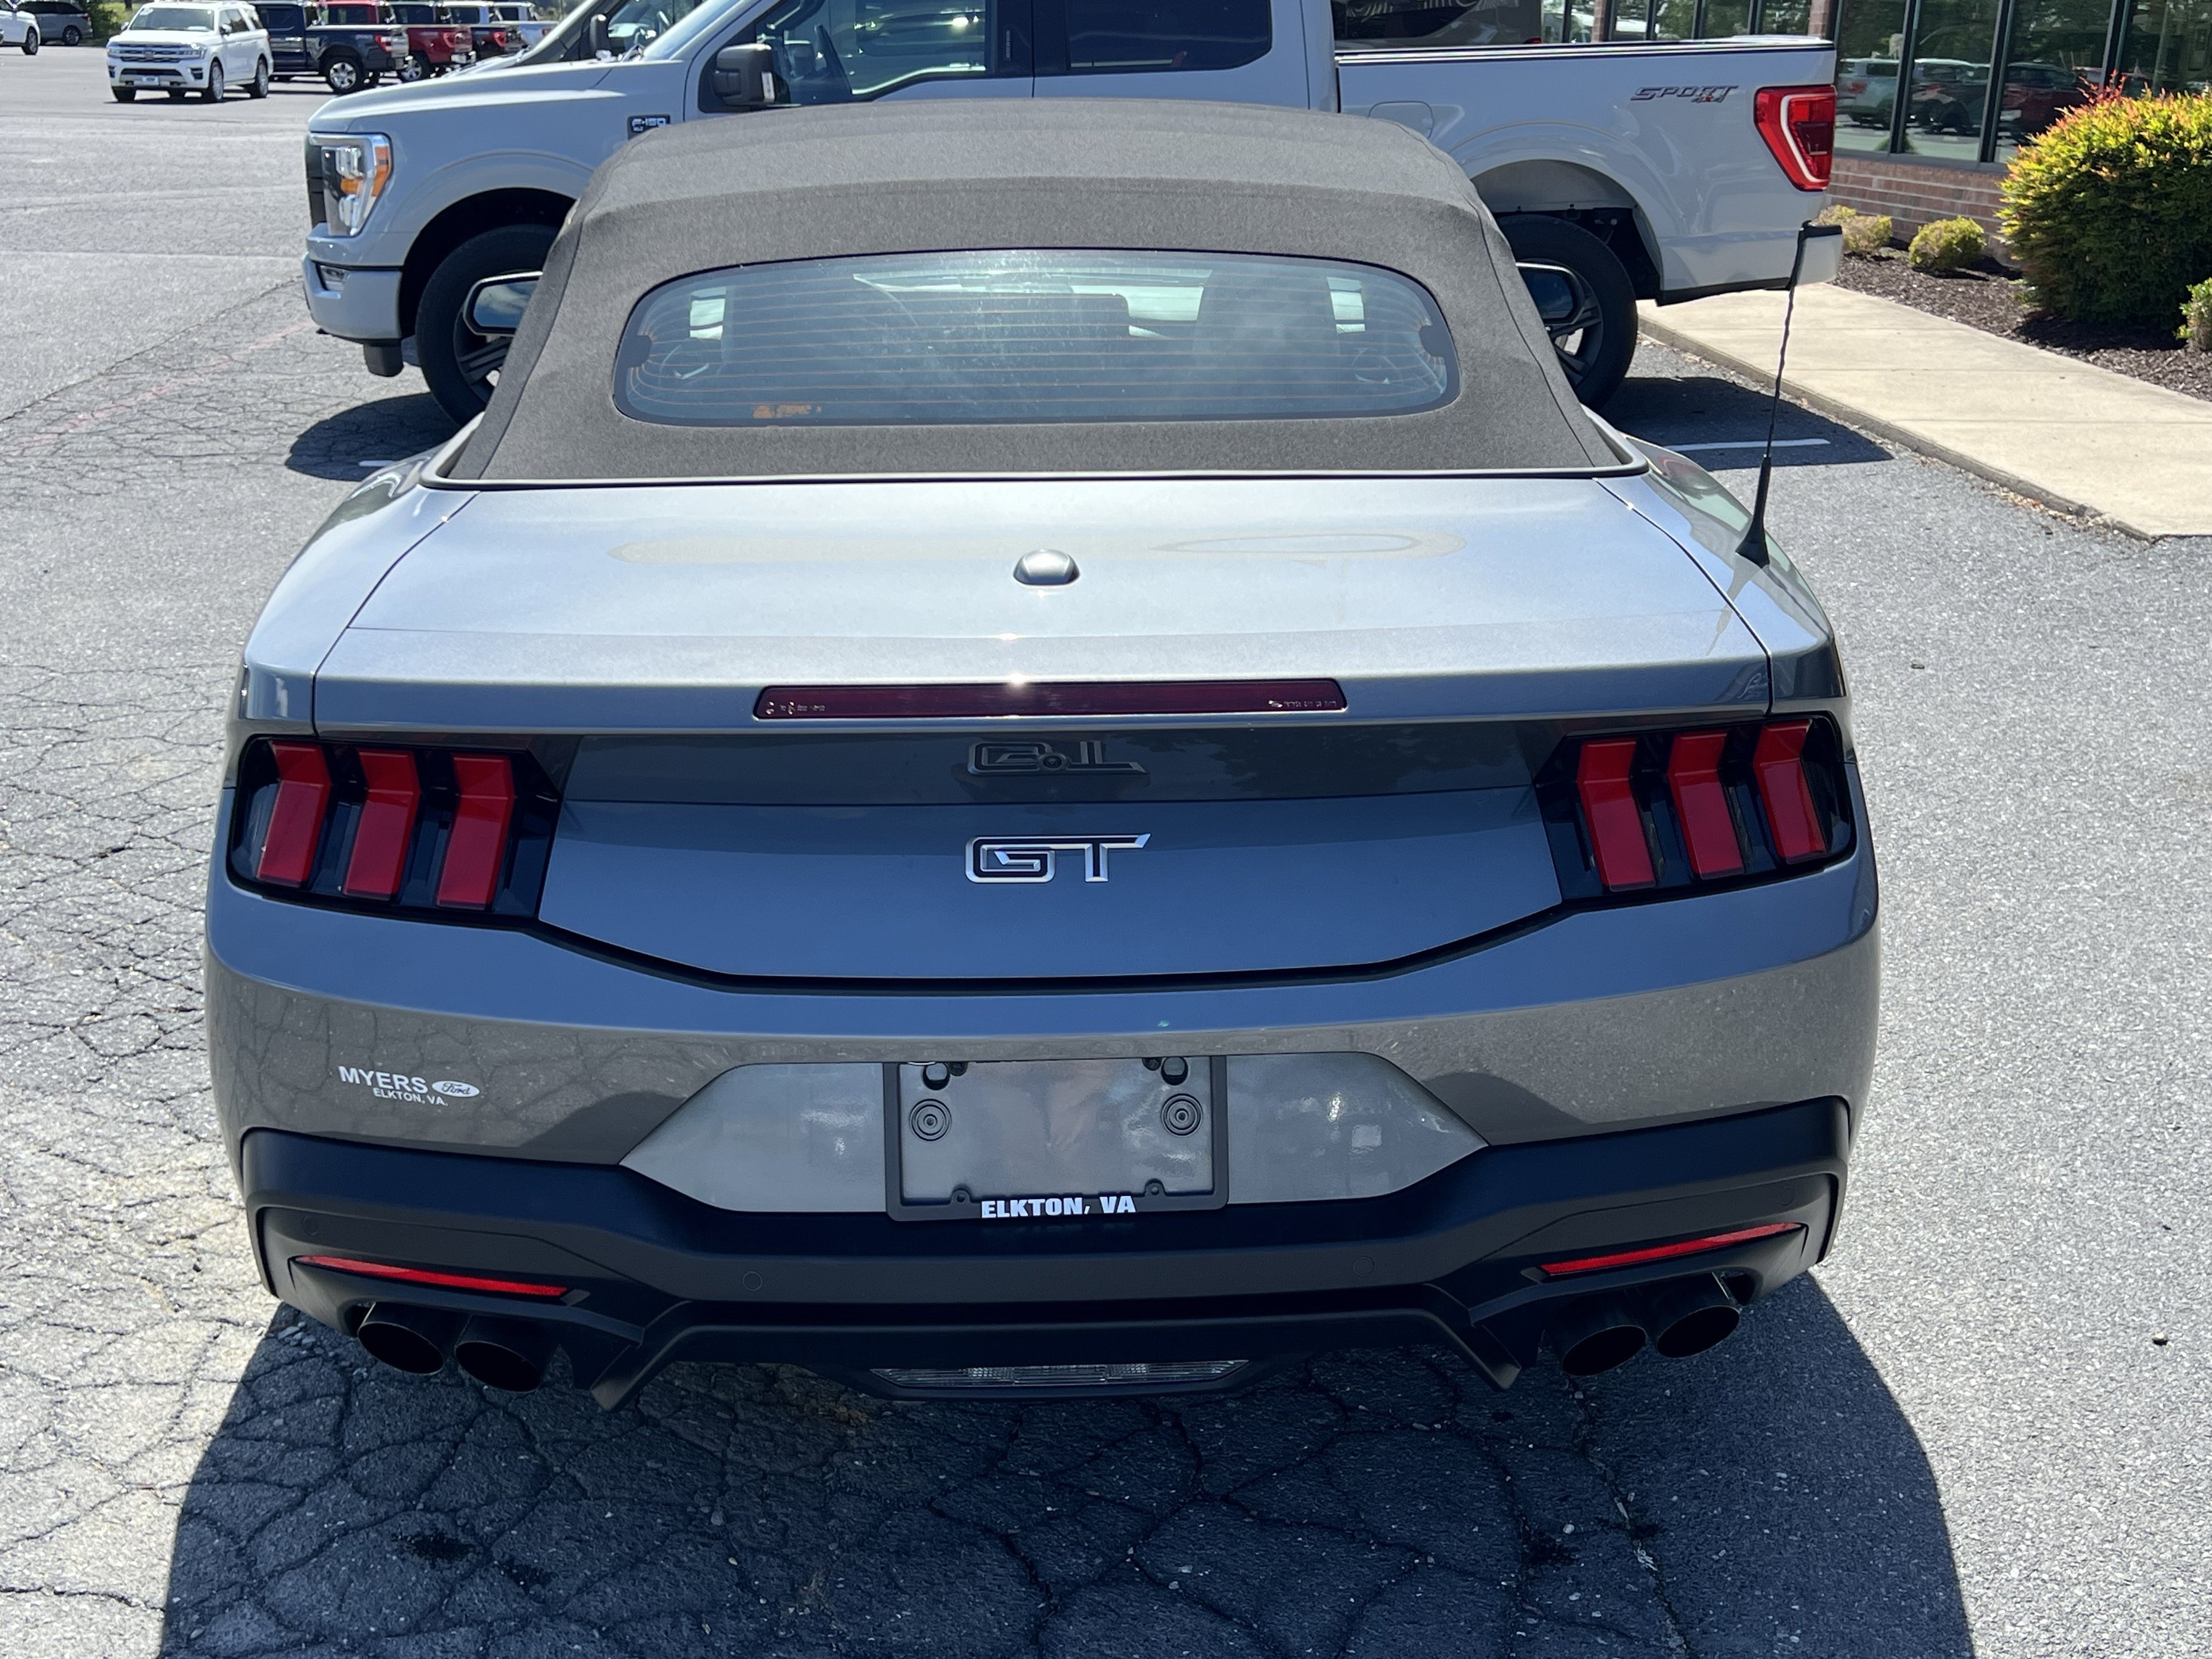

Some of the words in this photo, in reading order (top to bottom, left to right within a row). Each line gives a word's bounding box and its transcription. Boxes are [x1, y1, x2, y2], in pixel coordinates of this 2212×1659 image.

[1630, 85, 1739, 101] SPORT
[632, 117, 666, 127] F-150
[966, 833, 1152, 883] GT
[338, 1066, 428, 1093] MYERS
[426, 1095, 448, 1106] VA.
[981, 1197, 1090, 1218] ELKTON,
[1099, 1195, 1136, 1214] VA
